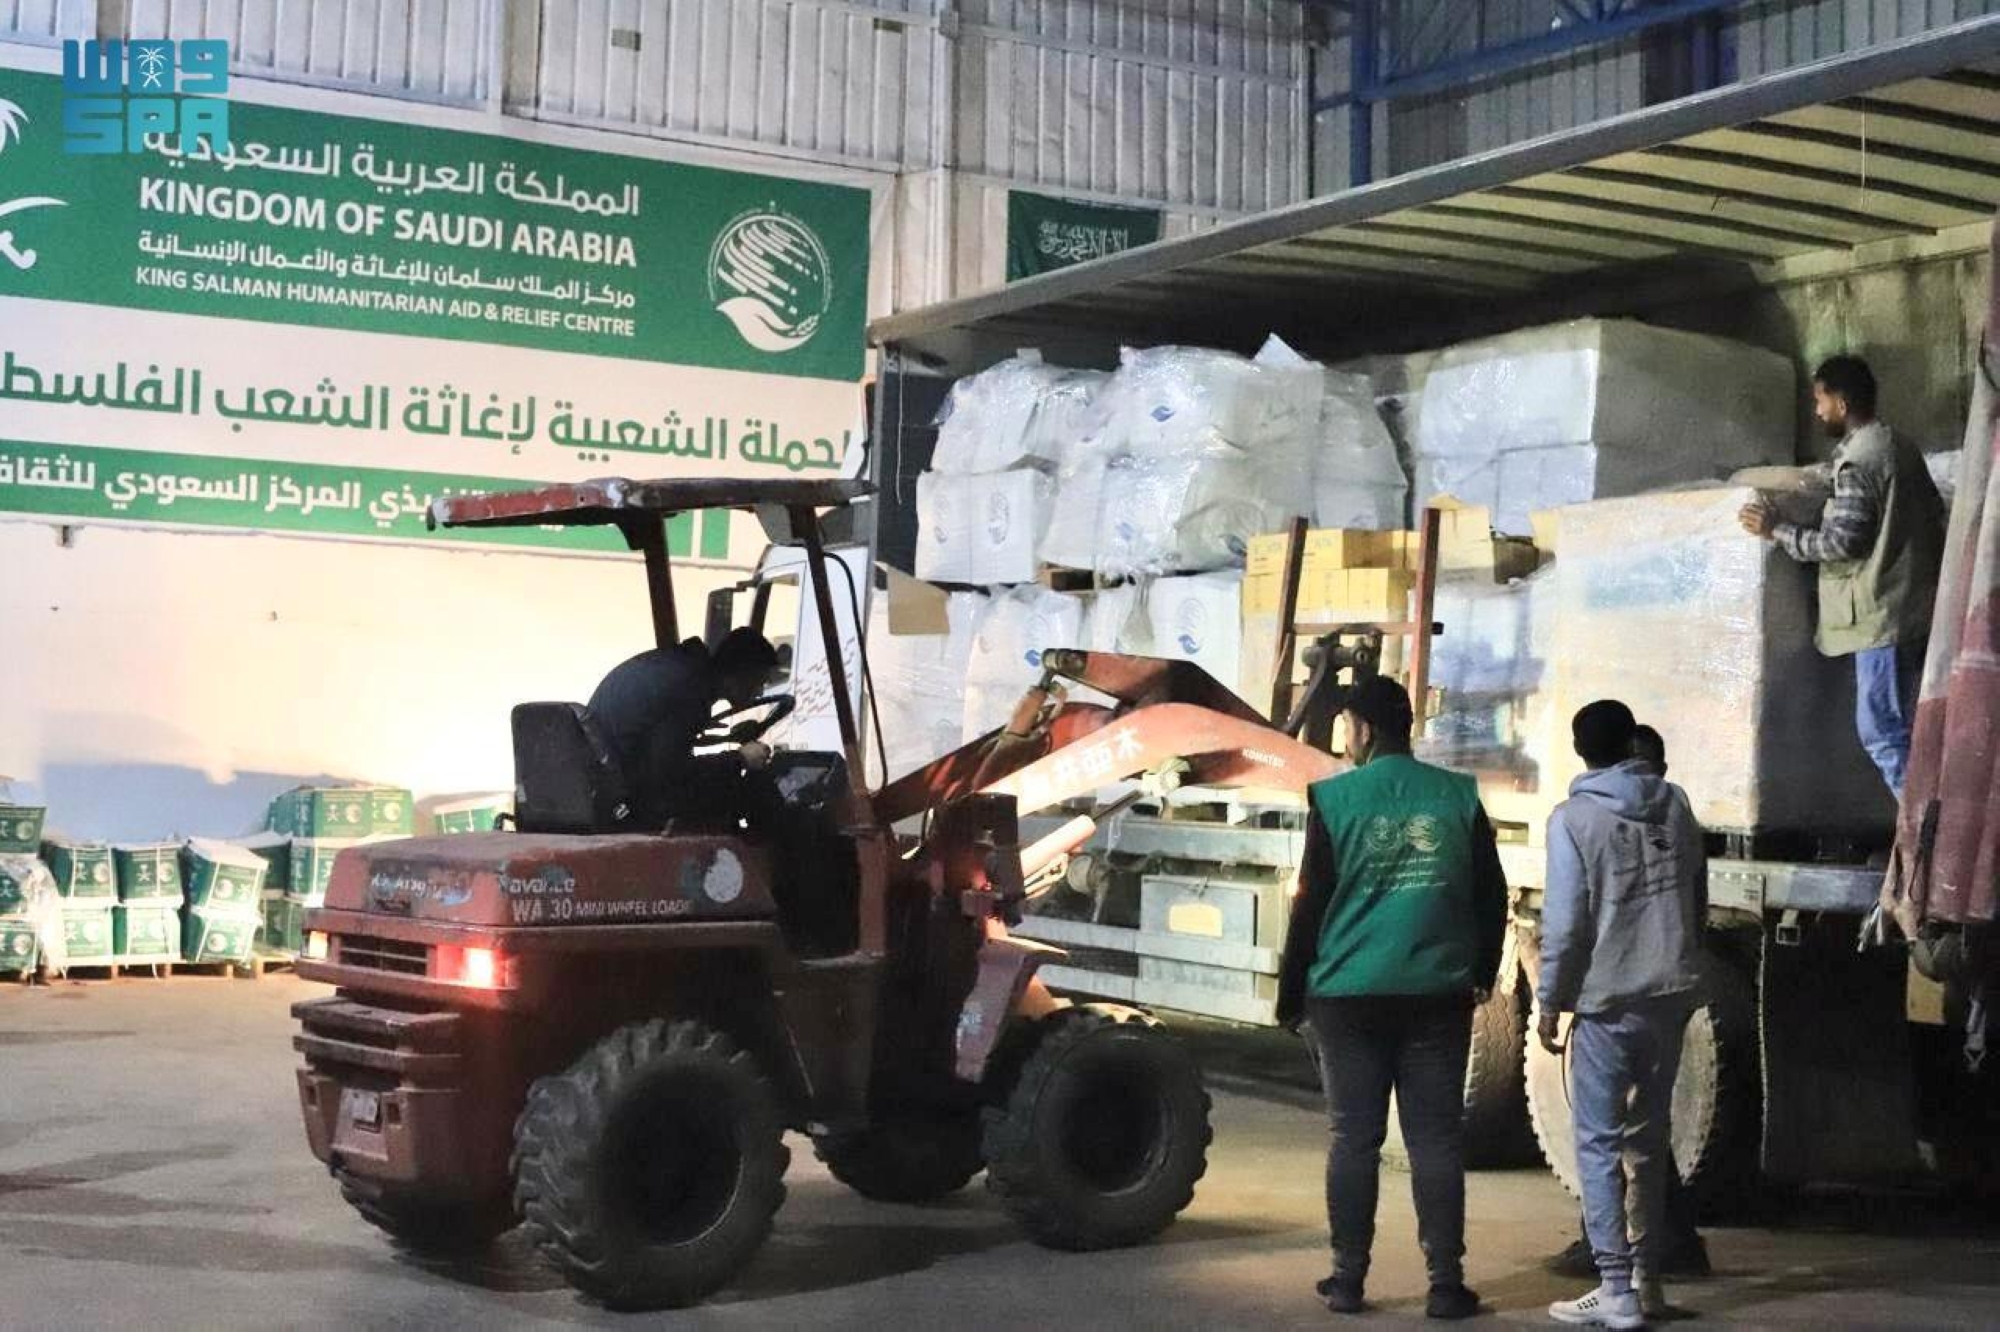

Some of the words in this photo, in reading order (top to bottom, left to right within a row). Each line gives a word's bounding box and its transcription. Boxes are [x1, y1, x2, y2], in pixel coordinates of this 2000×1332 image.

[352, 143, 485, 196] العربية
[495, 162, 639, 216] المملكة
[140, 176, 326, 230] KINGDOM
[335, 201, 385, 236] OF
[394, 208, 503, 250] SAUDI
[511, 223, 637, 268] ARABIA
[136, 266, 187, 288] KING
[192, 272, 282, 299] SALMAN
[287, 283, 444, 315] HUMANITARIAN
[448, 299, 482, 318] AID
[484, 303, 498, 321] &
[501, 304, 561, 328] RELIEF
[563, 312, 635, 337] CENTRE
[434, 264, 515, 291] سلمان
[519, 274, 580, 299] الملك
[582, 281, 635, 308] مركز
[0, 351, 201, 415] الفلسط
[214, 377, 389, 433] الشعب
[402, 384, 536, 455] لإغاثة
[548, 398, 727, 462] الشعبية
[738, 418, 851, 471] لحملة
[0, 453, 95, 490] للثقاف
[104, 469, 257, 510] السعودي
[264, 474, 361, 514] المركز
[511, 898, 543, 922] WA
[549, 898, 573, 920] 30
